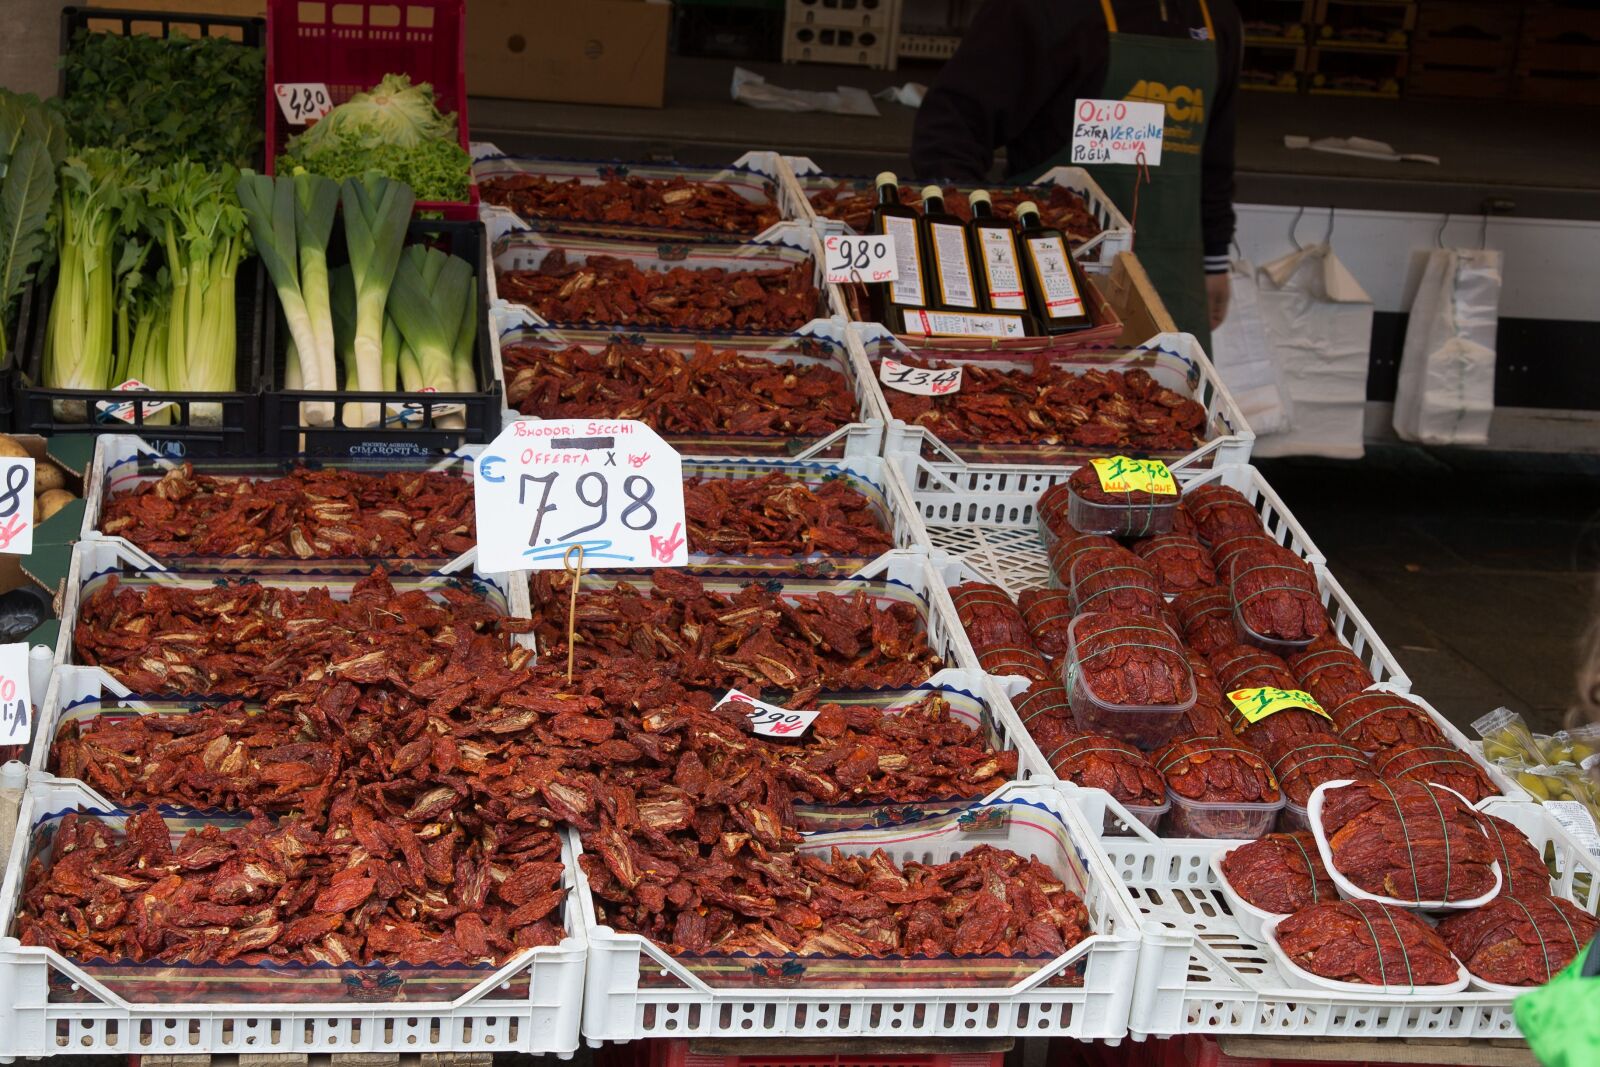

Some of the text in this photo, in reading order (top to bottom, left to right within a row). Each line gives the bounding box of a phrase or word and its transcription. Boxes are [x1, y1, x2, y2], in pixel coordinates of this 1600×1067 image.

[585, 423, 634, 436] SECCHI
[520, 448, 590, 464] OFFERTA
[519, 471, 658, 547] 7.98
